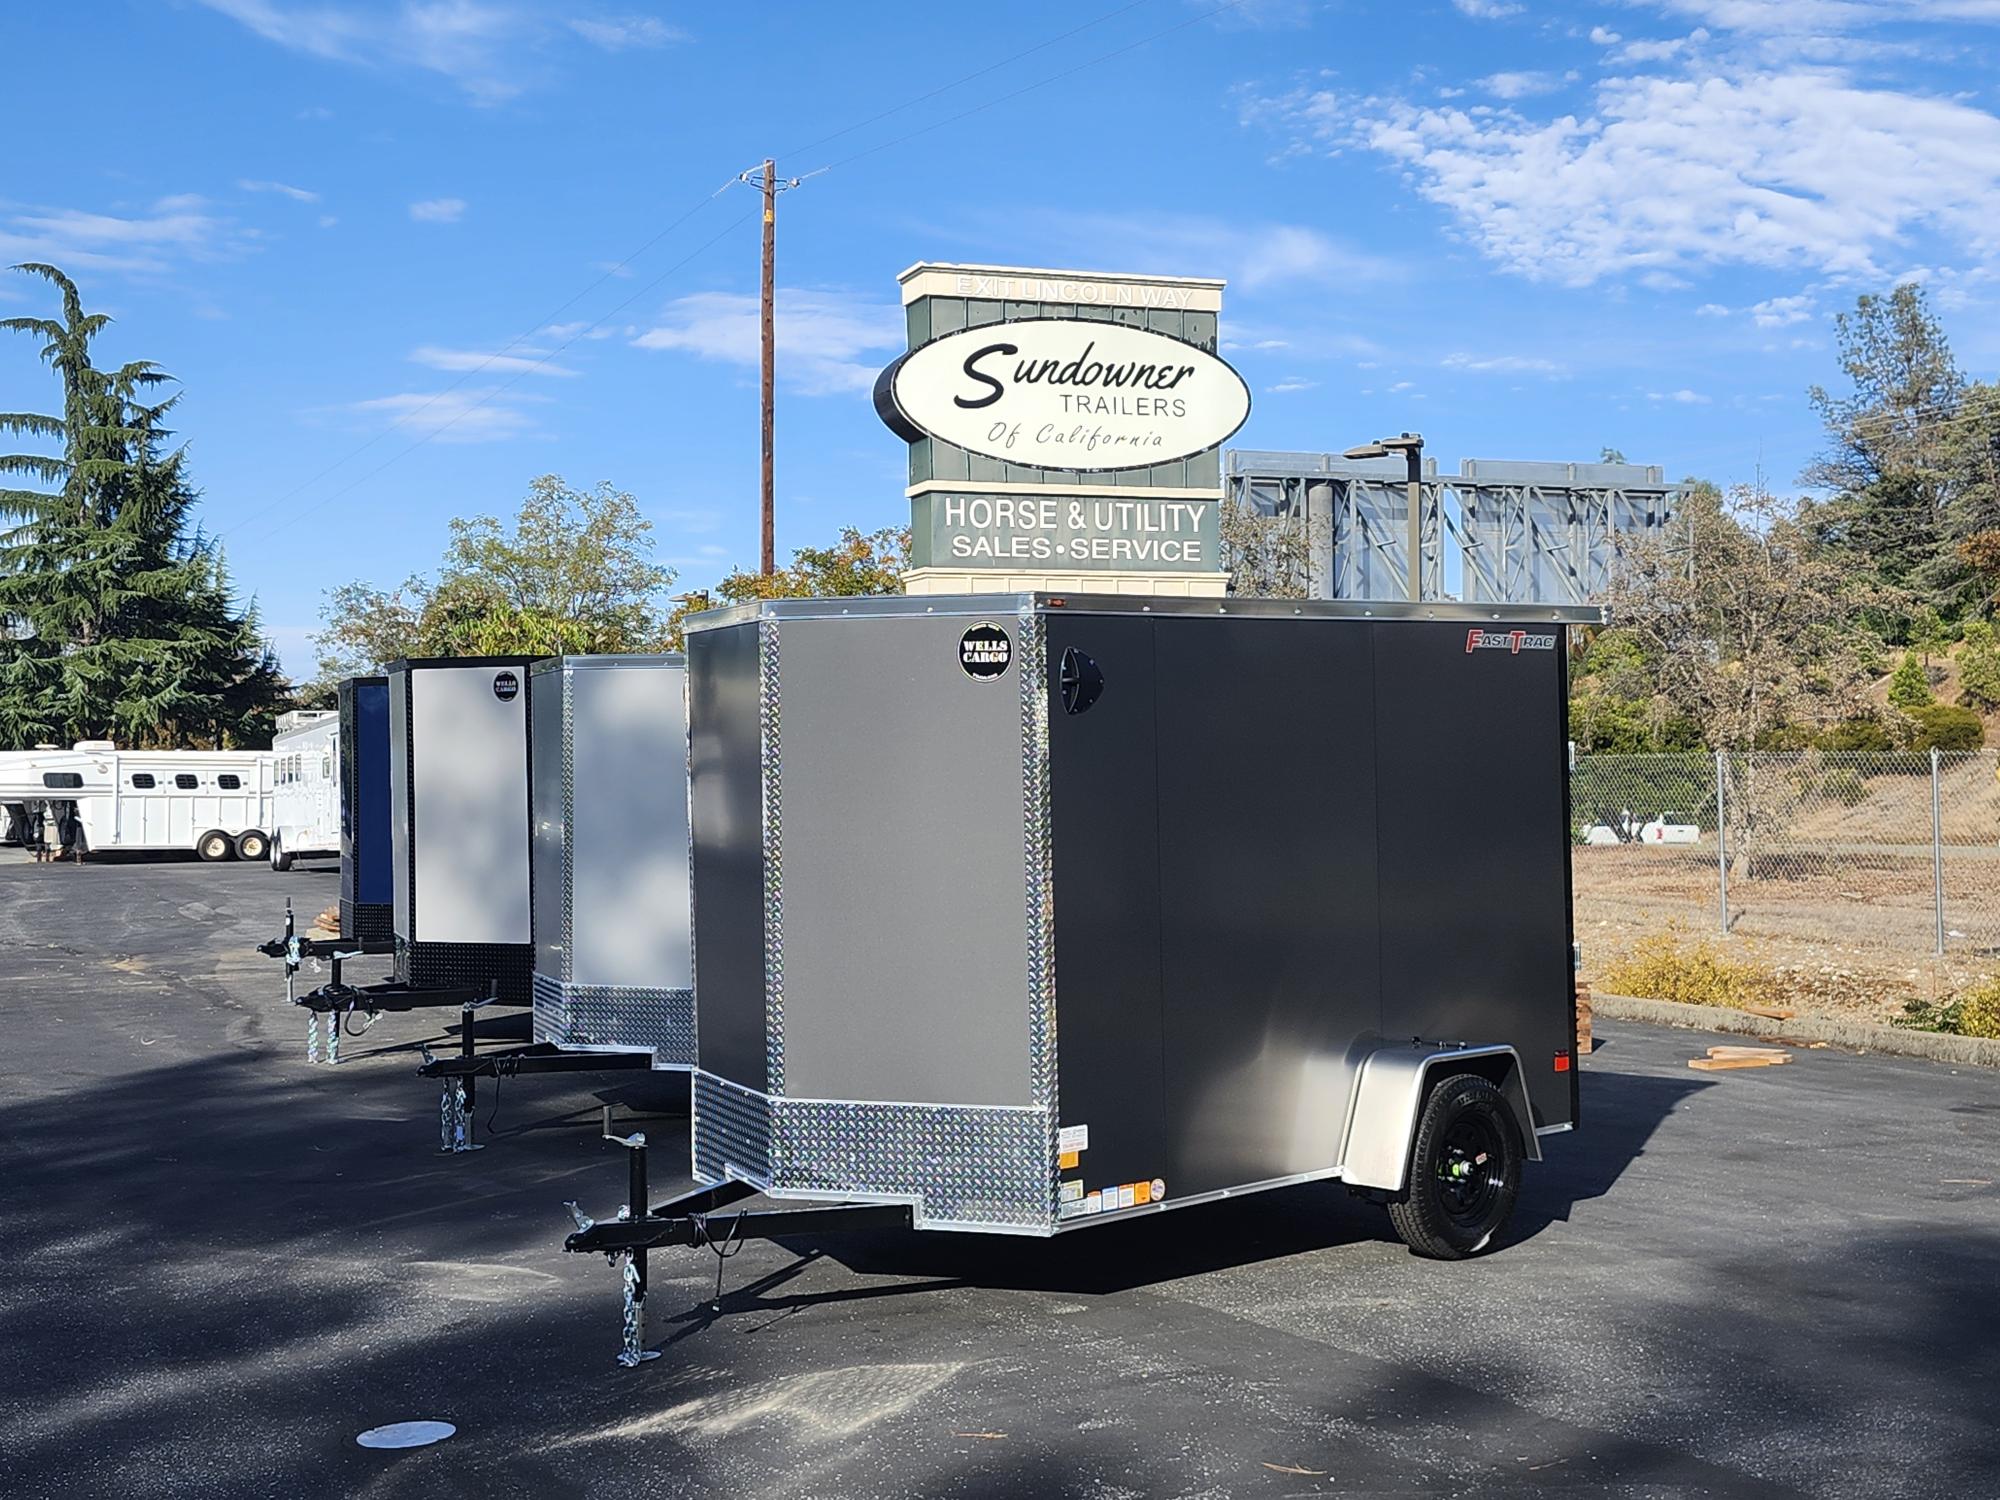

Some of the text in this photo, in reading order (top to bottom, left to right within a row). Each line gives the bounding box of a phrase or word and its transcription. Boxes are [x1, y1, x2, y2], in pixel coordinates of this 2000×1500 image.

[956, 276, 1194, 308] EXIT LINCOLN WAY
[953, 341, 1195, 409] Sundowner
[1059, 394, 1187, 418] TRAILERS
[988, 421, 1163, 452] Of California
[945, 497, 1207, 533] HORSE & UTILITY
[963, 640, 1008, 651] WELLS
[963, 651, 1008, 663] CARGO
